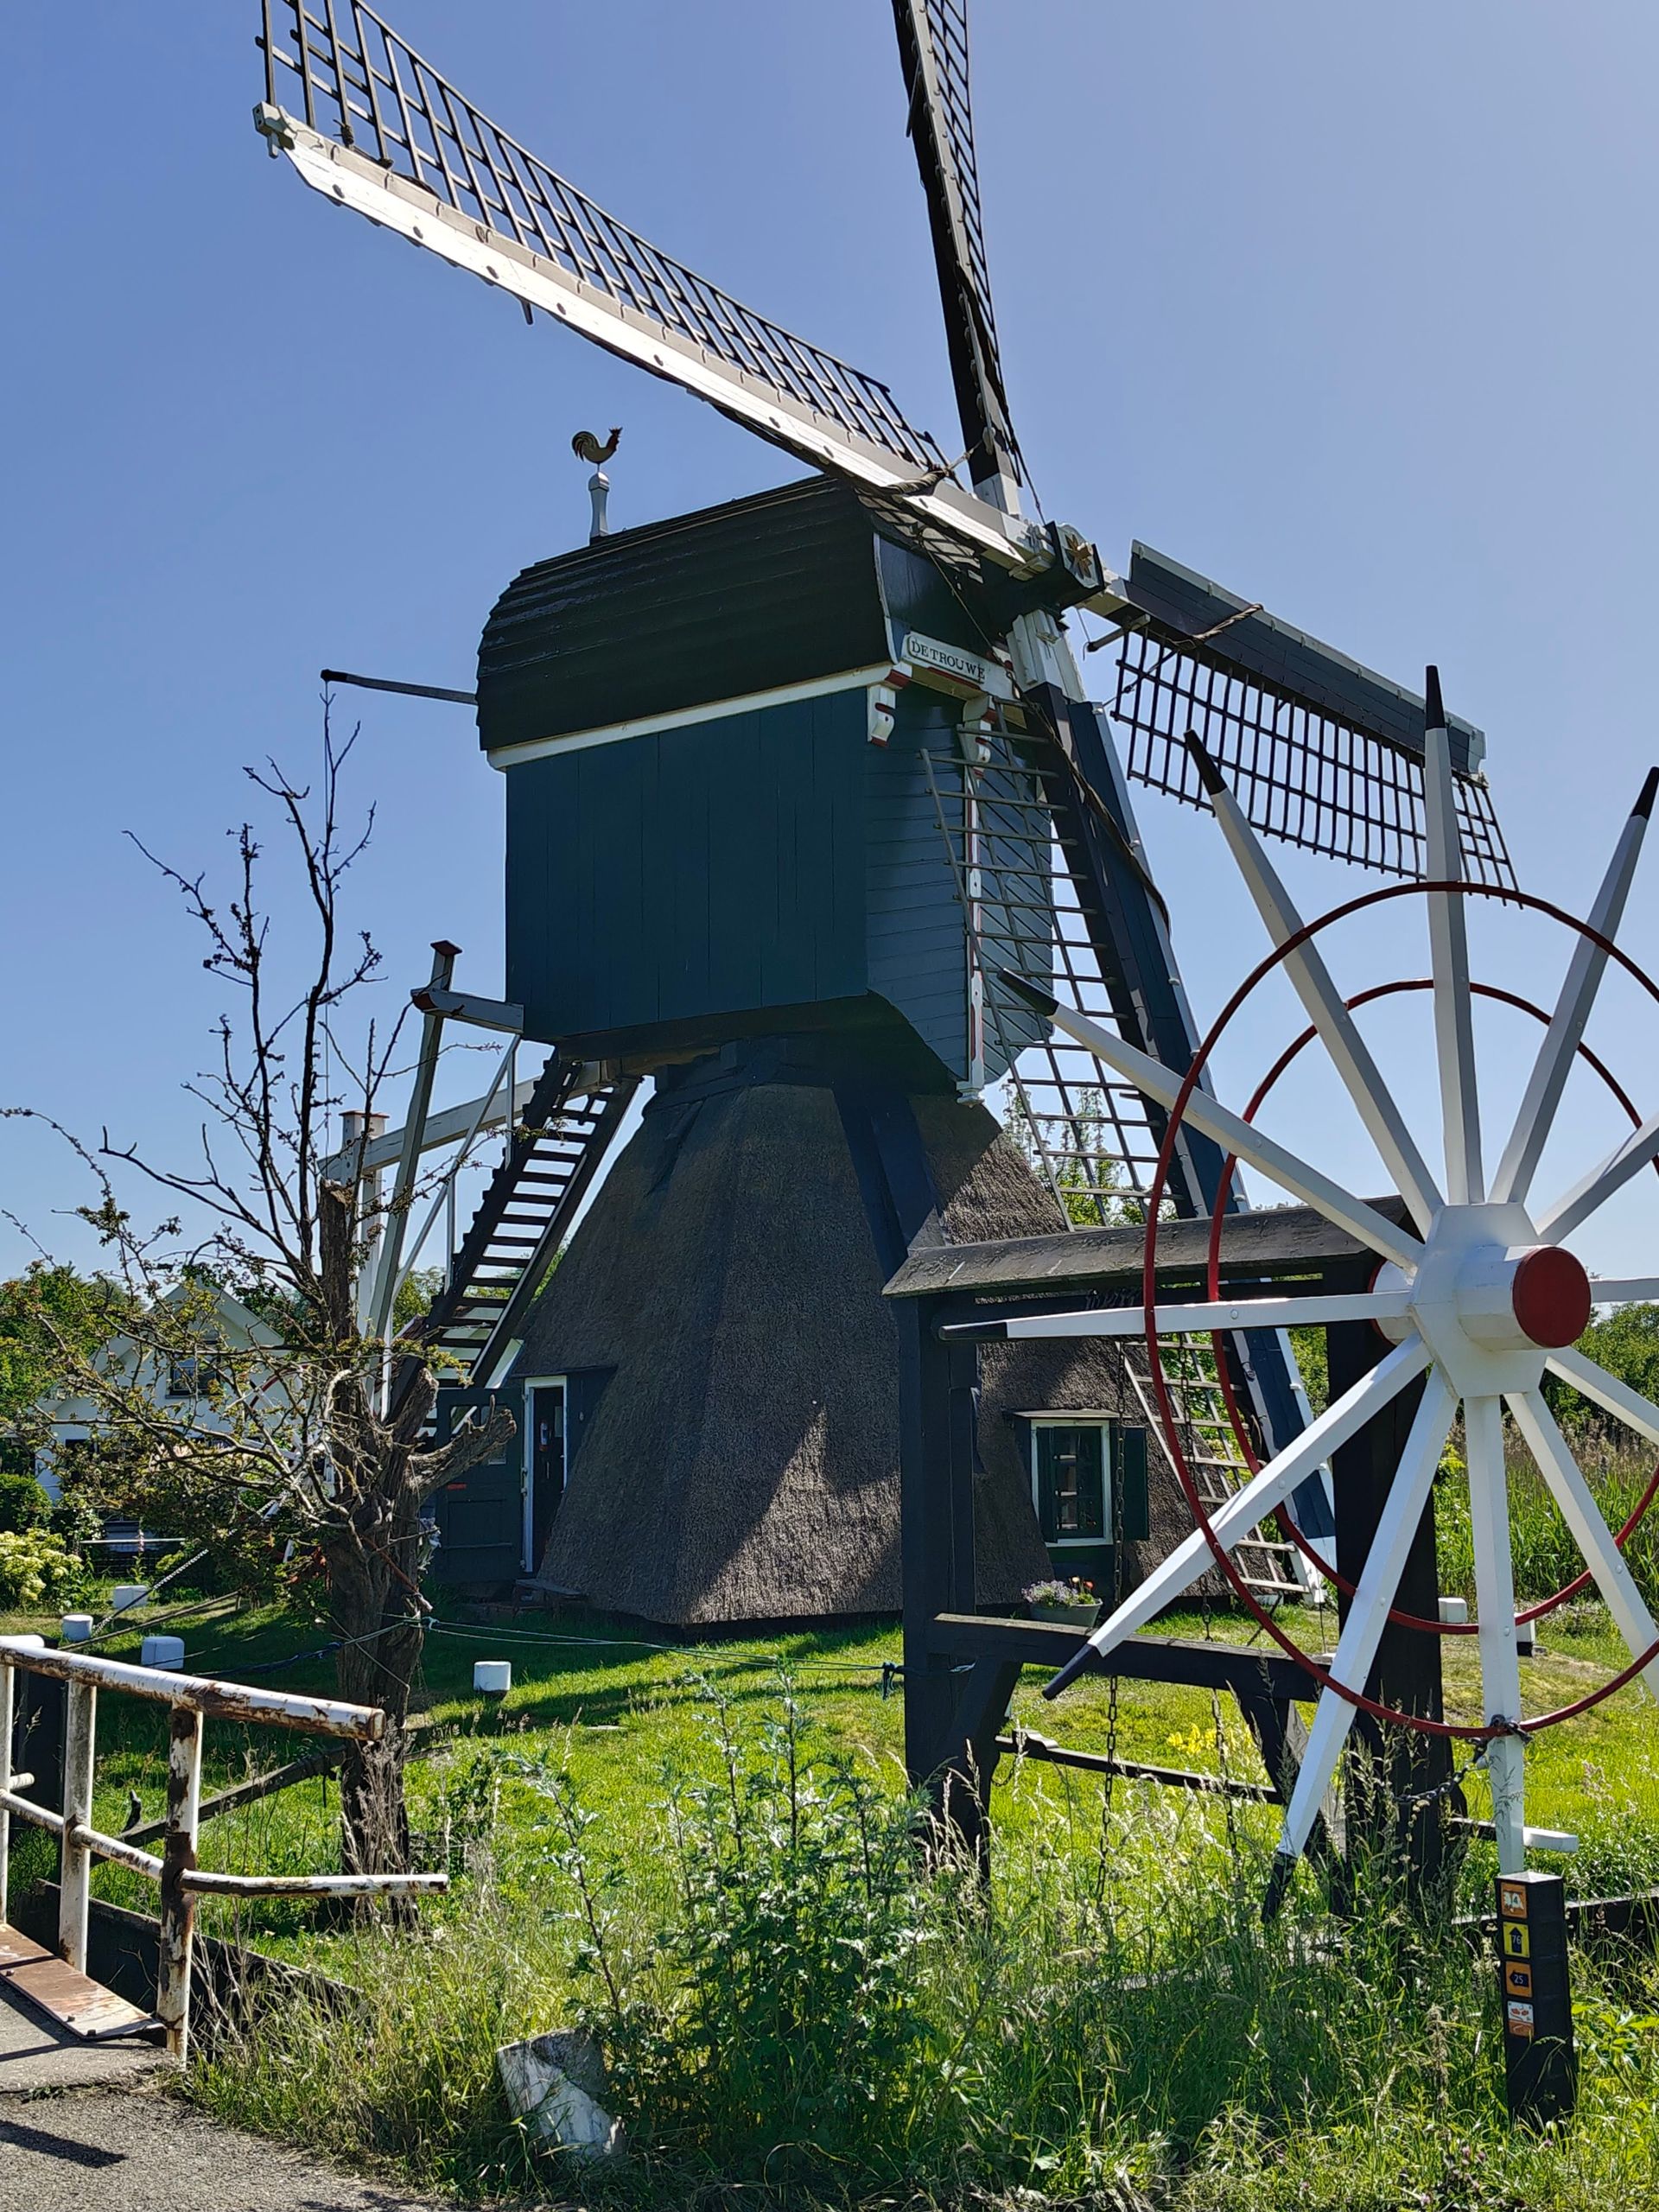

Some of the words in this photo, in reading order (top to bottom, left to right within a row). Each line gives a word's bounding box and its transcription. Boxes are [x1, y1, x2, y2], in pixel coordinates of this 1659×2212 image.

[912, 640, 929, 658] DE
[930, 648, 985, 679] TROUWE
[1512, 1935, 1522, 1945] 76
[1514, 1974, 1523, 1985] 25
